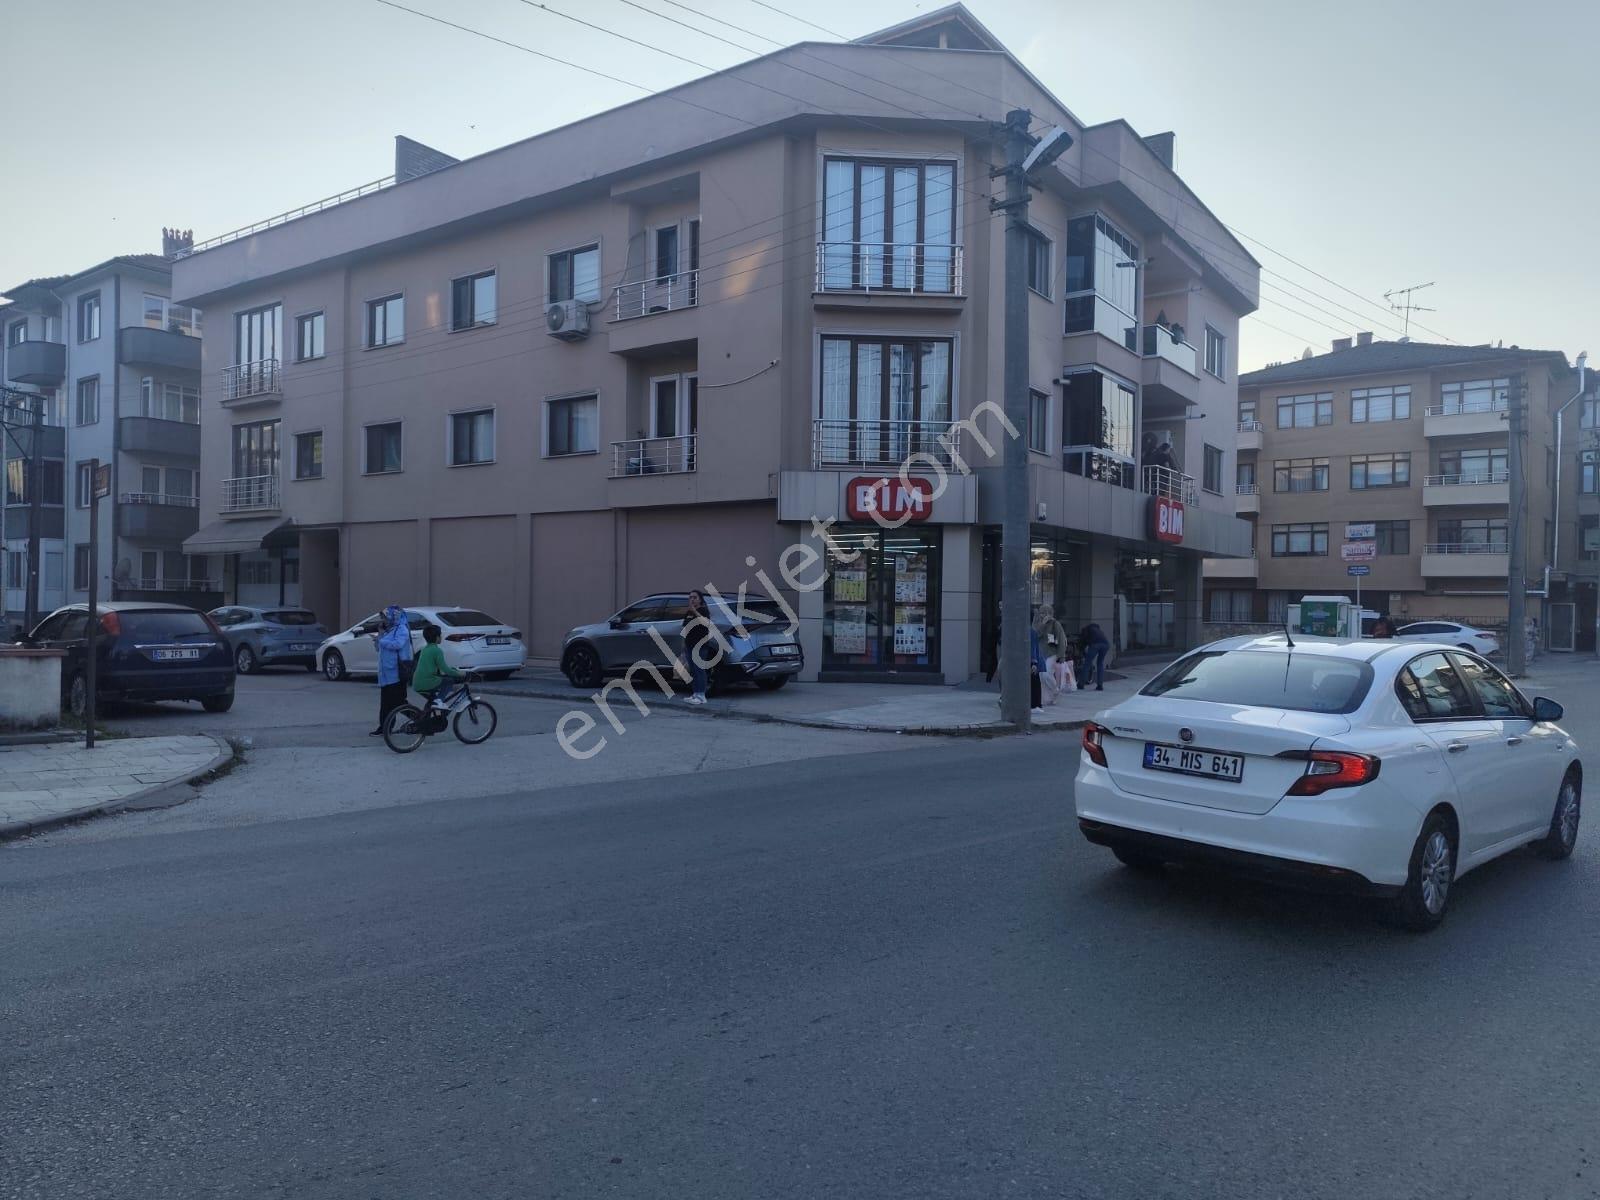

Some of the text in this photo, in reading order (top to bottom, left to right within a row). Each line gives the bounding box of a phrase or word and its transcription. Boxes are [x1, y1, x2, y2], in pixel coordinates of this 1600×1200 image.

[1153, 747, 1238, 775] 34 MIS 641
